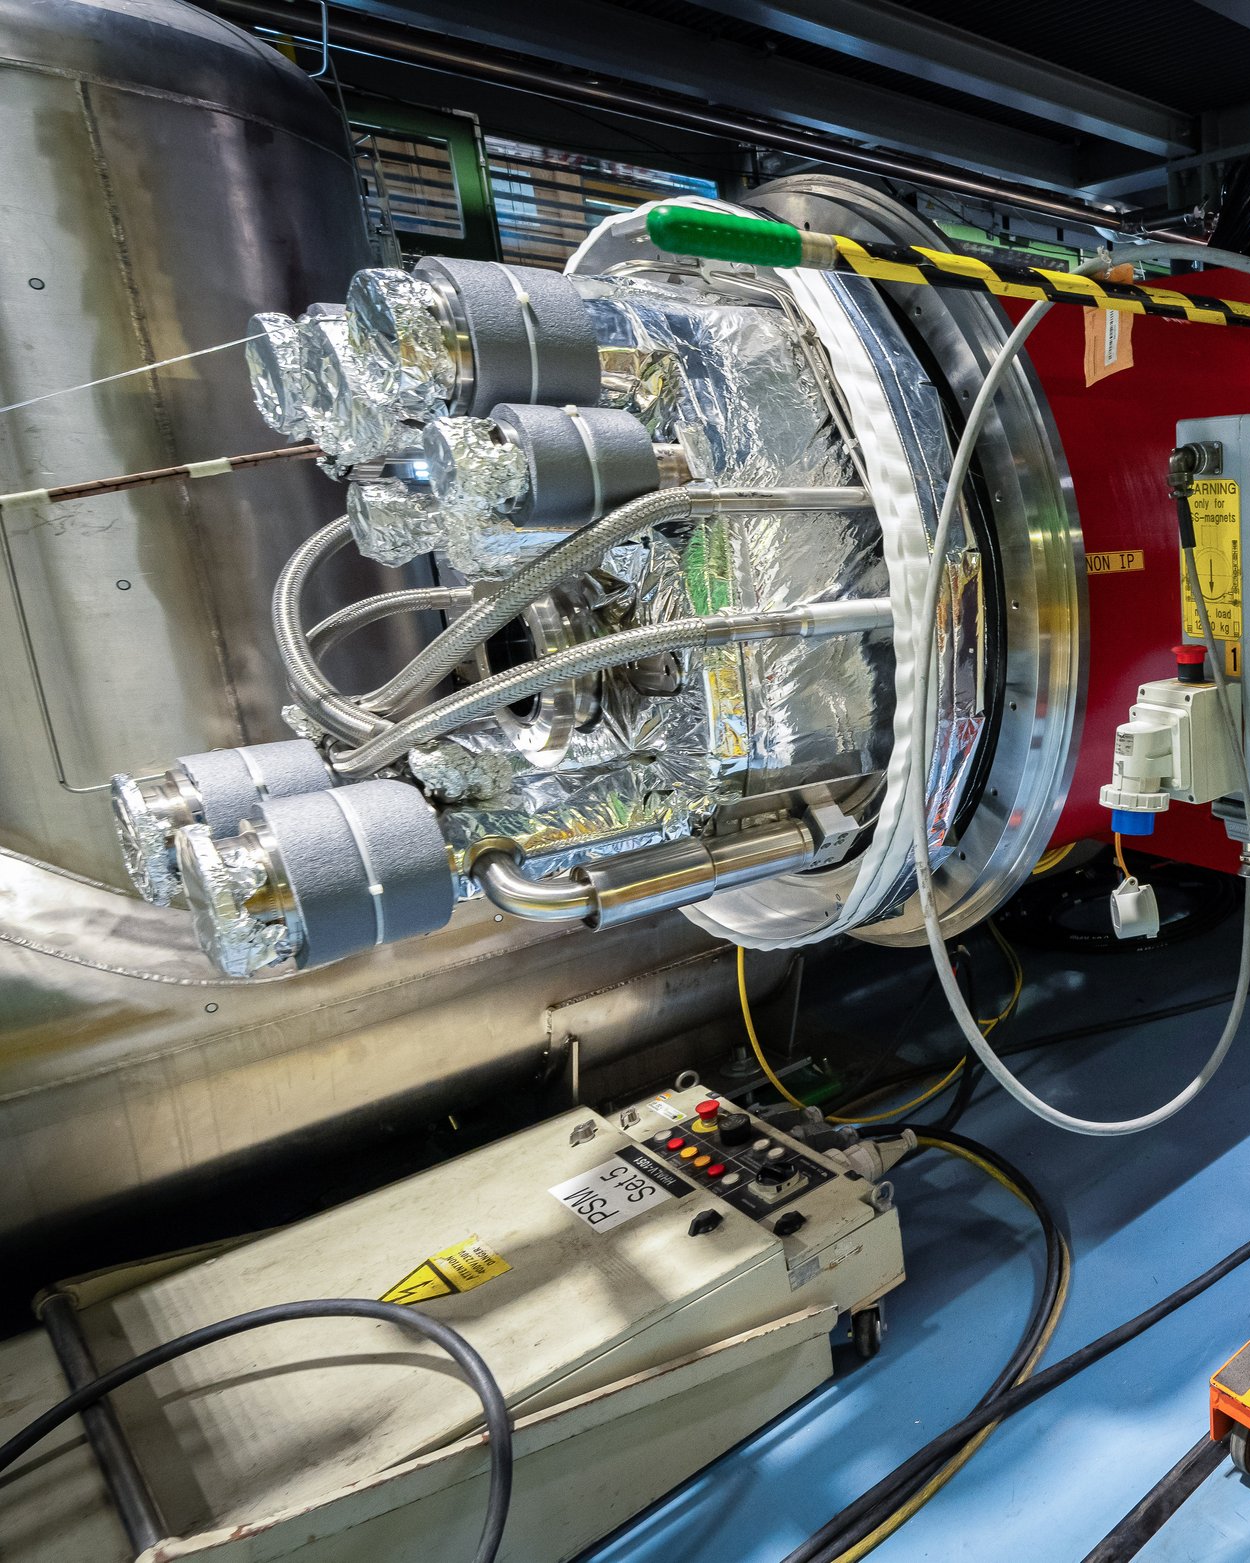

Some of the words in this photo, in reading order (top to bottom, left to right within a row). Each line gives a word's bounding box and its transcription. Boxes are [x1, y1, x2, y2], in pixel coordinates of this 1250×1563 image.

[1192, 483, 1236, 495] ARNING
[1194, 498, 1209, 510] only
[1214, 498, 1224, 508] for
[1085, 555, 1111, 571] NON
[1119, 553, 1135, 569] IP
[1216, 608, 1231, 619] load
[1195, 620, 1216, 631] 120
[1220, 620, 1230, 634] kg
[1231, 647, 1237, 672] 1
[600, 1166, 629, 1182] 5
[613, 1174, 657, 1203] Set
[562, 1186, 620, 1225] PSM
